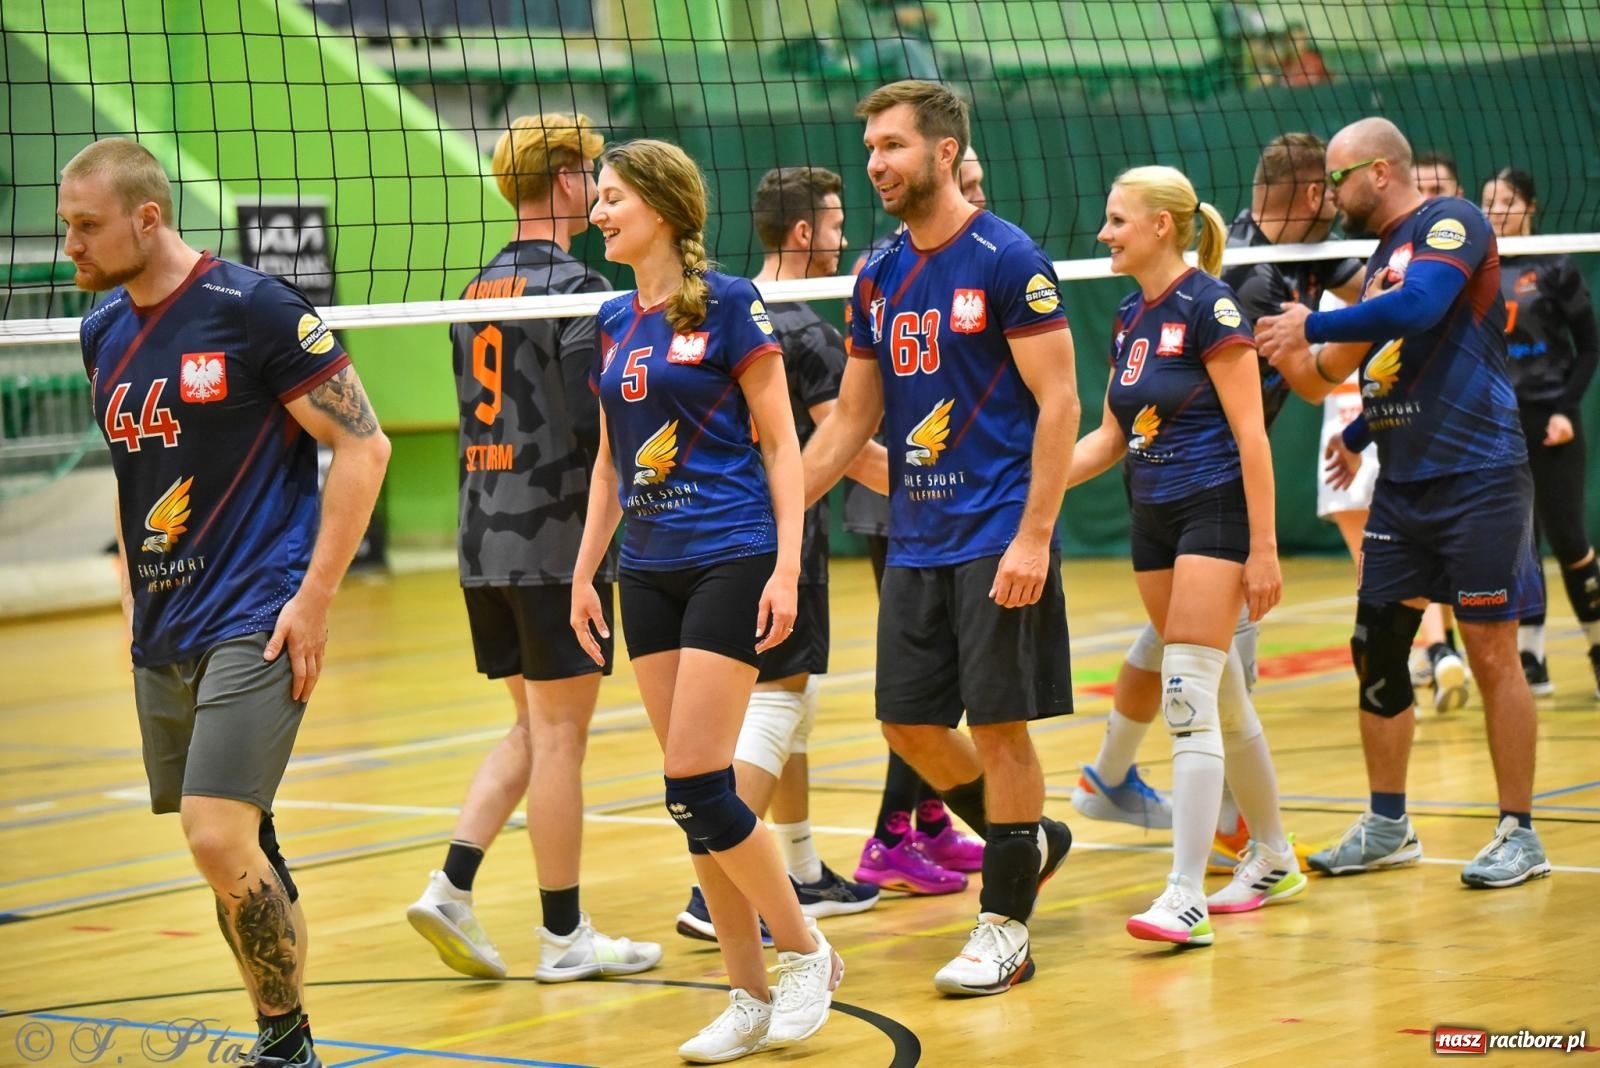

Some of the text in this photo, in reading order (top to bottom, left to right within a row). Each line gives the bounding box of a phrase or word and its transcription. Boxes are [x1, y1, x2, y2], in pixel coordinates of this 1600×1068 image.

[202, 283, 242, 298] AURATOR
[890, 308, 941, 377] 63
[1121, 338, 1149, 386] 9
[472, 324, 503, 426] 9
[621, 346, 653, 402] 5
[105, 378, 181, 452] 44
[659, 482, 699, 500] SPORT
[928, 471, 964, 486] SPORT
[160, 555, 206, 576] SPORT
